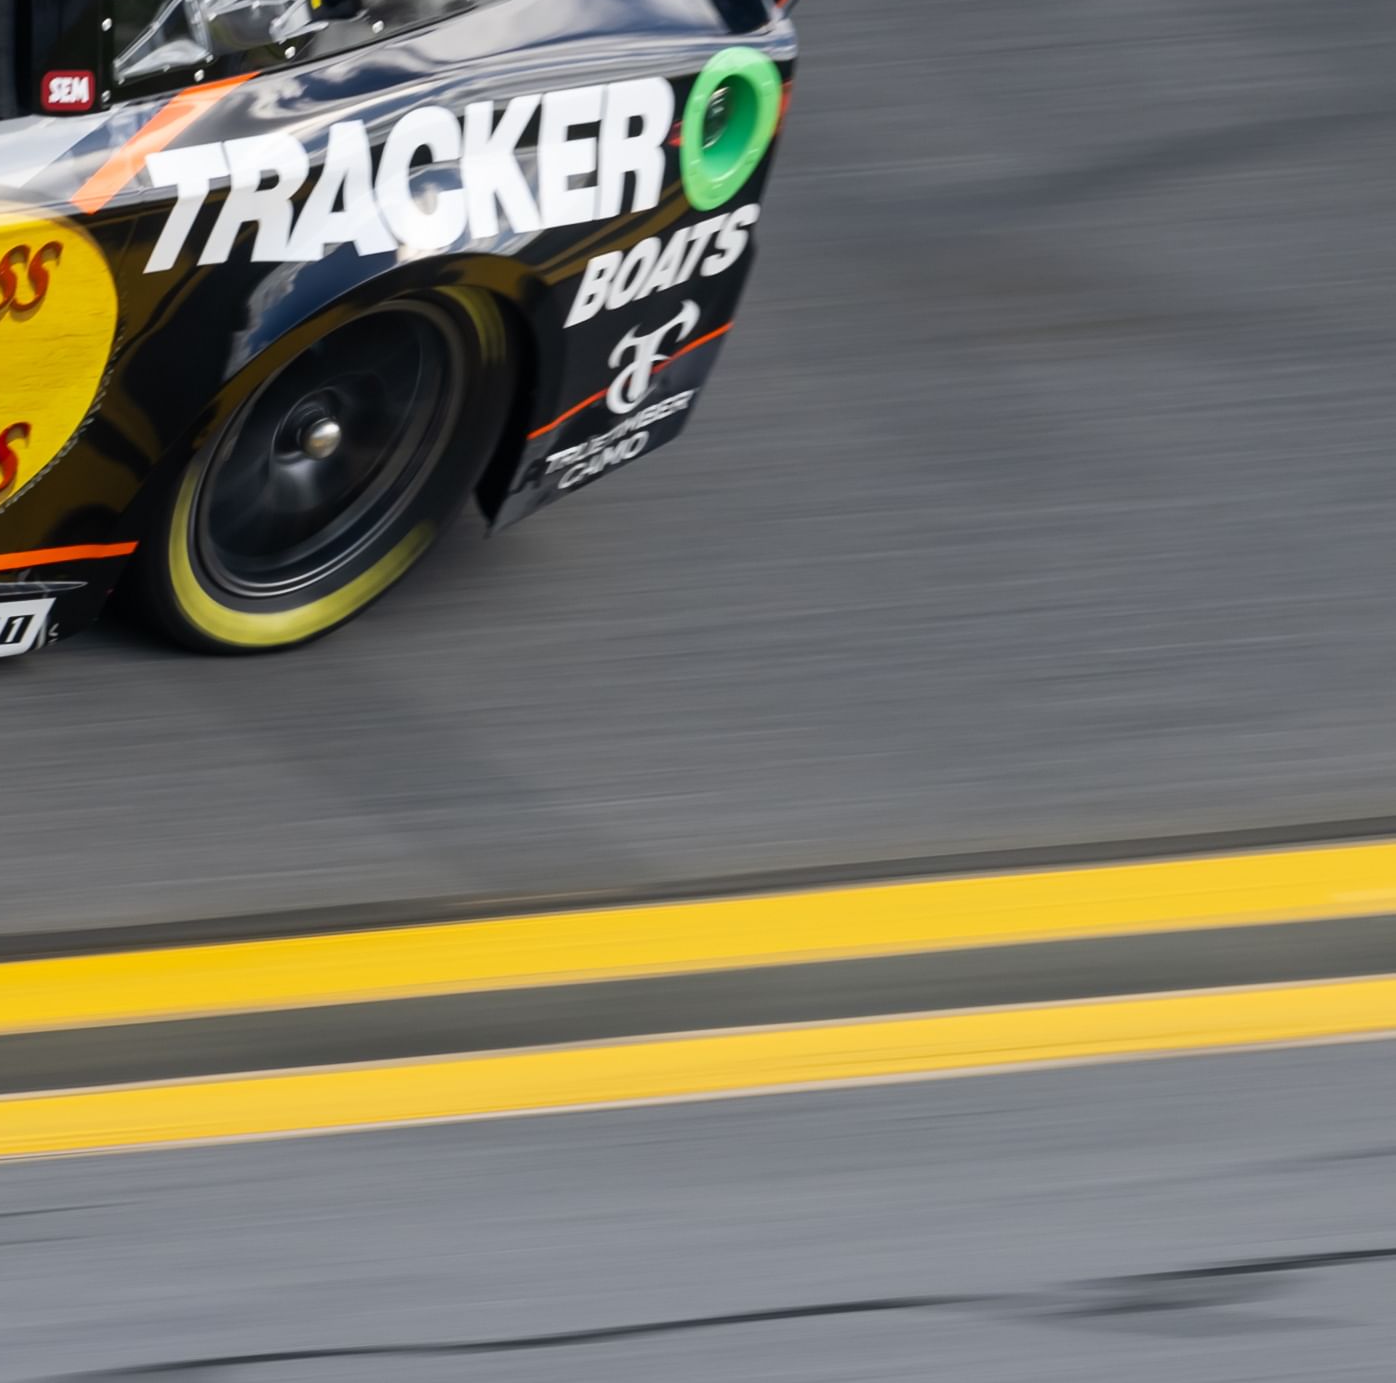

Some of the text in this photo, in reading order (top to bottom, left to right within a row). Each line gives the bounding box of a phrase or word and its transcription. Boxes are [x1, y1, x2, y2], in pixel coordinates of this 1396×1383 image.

[49, 77, 89, 103] SEM
[143, 76, 675, 273] TRACKER
[563, 203, 760, 328] BOATS
